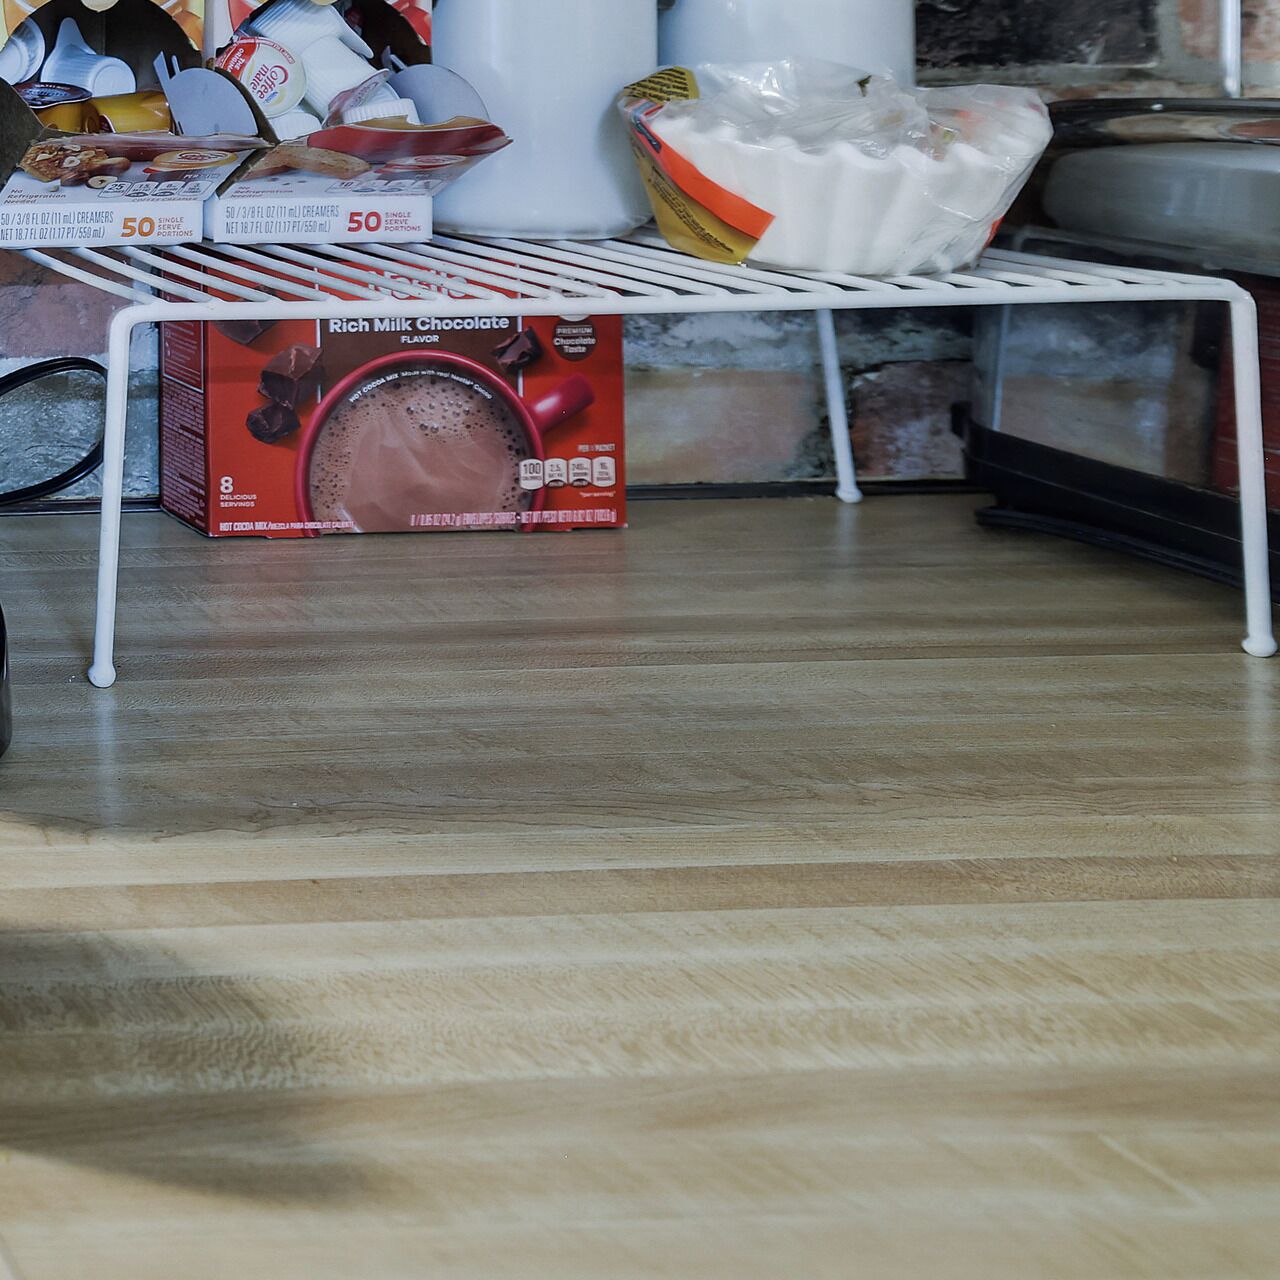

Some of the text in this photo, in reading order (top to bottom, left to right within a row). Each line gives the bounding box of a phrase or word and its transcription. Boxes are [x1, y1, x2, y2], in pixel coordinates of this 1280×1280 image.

[250, 63, 270, 91] mate
[257, 65, 289, 99] Coffee
[108, 183, 126, 191] 25
[0, 213, 10, 225] 50
[16, 213, 31, 225] 3/8
[32, 212, 39, 225] FL
[40, 212, 50, 225] OZ
[52, 211, 62, 226] (11
[77, 211, 114, 224] CREAMERS
[225, 206, 235, 219] 50
[242, 206, 256, 218] 3/8
[257, 206, 265, 218] FL
[266, 206, 275, 218] OZ
[276, 205, 287, 219] (11
[302, 205, 339, 217] CREAMERS
[121, 217, 155, 238] 50
[225, 222, 239, 234] NET
[240, 222, 254, 234] 18.7
[255, 222, 264, 234] FL
[265, 221, 274, 234] OZ
[347, 211, 381, 232] 50
[0, 228, 14, 241] NET
[15, 228, 30, 240] 18.7
[31, 228, 38, 240] FL
[39, 228, 48, 240] OZ
[49, 227, 65, 240] (1.17
[329, 316, 510, 333] Rich Milk Chocolate
[556, 326, 592, 335] PREMIUM
[400, 334, 440, 344] FLAVOR
[553, 337, 596, 346] Chocolate
[563, 345, 587, 354] Taste
[349, 390, 363, 403] HOT
[362, 377, 386, 393] COCOA
[385, 373, 400, 382] MIX
[523, 463, 541, 475] 100
[220, 476, 234, 493] 8
[219, 522, 233, 532] HOT
[233, 521, 254, 531] COCOA
[305, 522, 332, 530] CHOCOLATE
